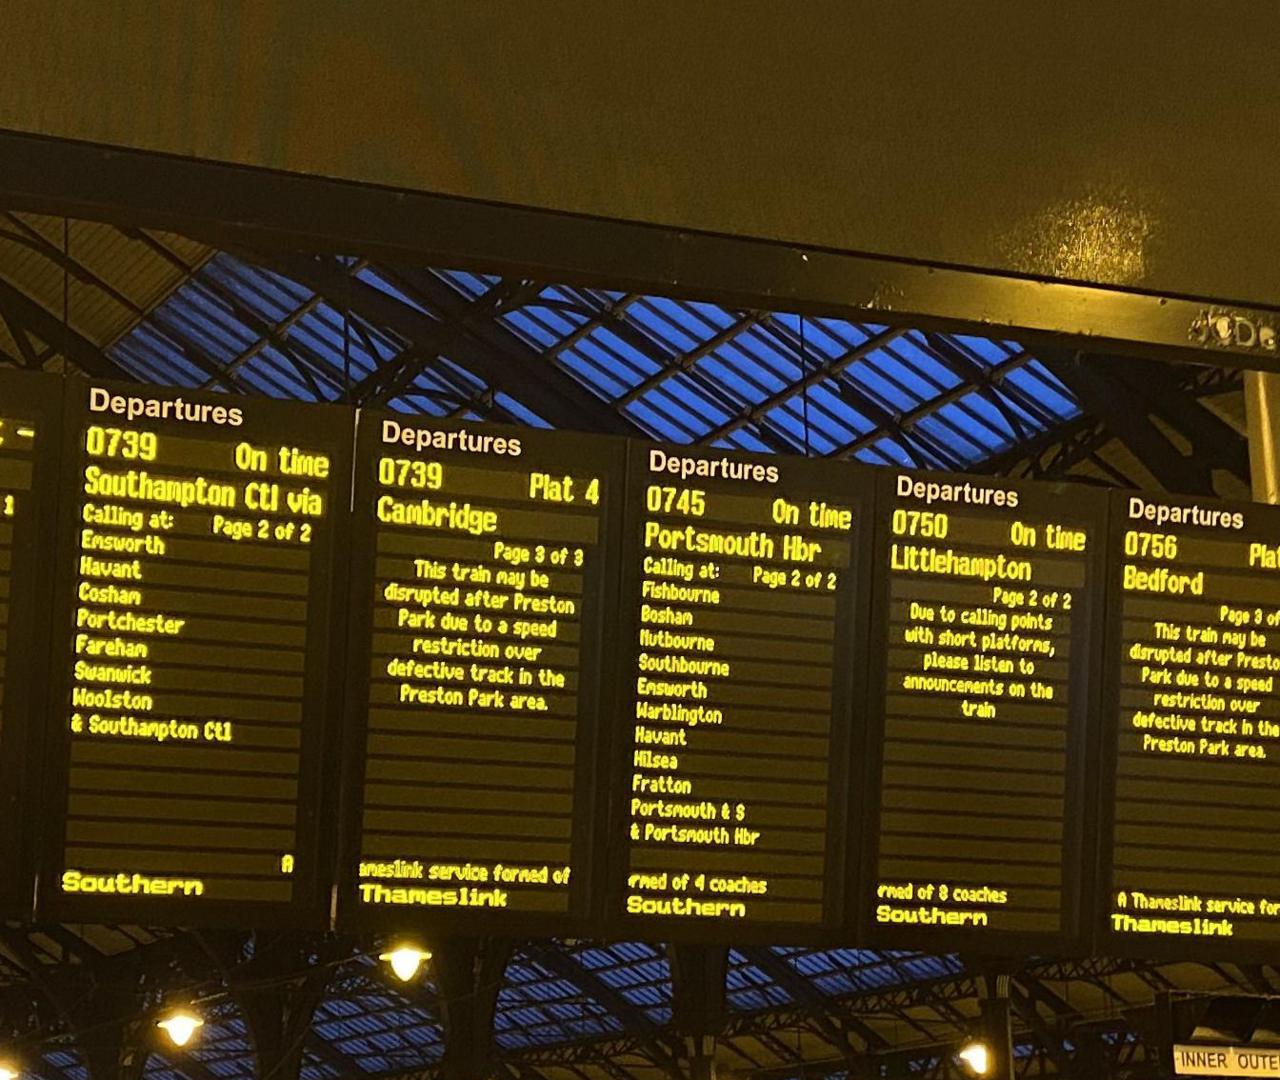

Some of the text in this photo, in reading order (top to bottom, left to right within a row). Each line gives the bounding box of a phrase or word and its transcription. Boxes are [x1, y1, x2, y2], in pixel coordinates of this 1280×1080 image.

[90, 387, 243, 426] Departures
[86, 425, 330, 478] 0739 On time
[382, 420, 522, 456] Departures
[378, 457, 600, 505] 0739 Plat 4
[649, 449, 779, 483] Departures
[84, 465, 322, 516] Southampton Ctl via
[646, 485, 852, 530] 0745 On time
[897, 475, 1019, 508] Departures
[377, 495, 498, 536] Cambridge
[892, 509, 1087, 552] 0750 On time
[1129, 497, 1244, 530] Departures
[644, 521, 822, 563] Portsmouth Hbr
[1124, 530, 1178, 560] 0756
[890, 543, 1032, 582] Littlehampton
[1123, 564, 1204, 596] Bedford
[61, 870, 204, 896] Southern
[358, 883, 508, 907] Thameslink
[626, 895, 746, 917] Southern
[876, 904, 988, 926] Southern
[1110, 913, 1234, 936] Thameslink
[1181, 1052, 1228, 1068] INNER
